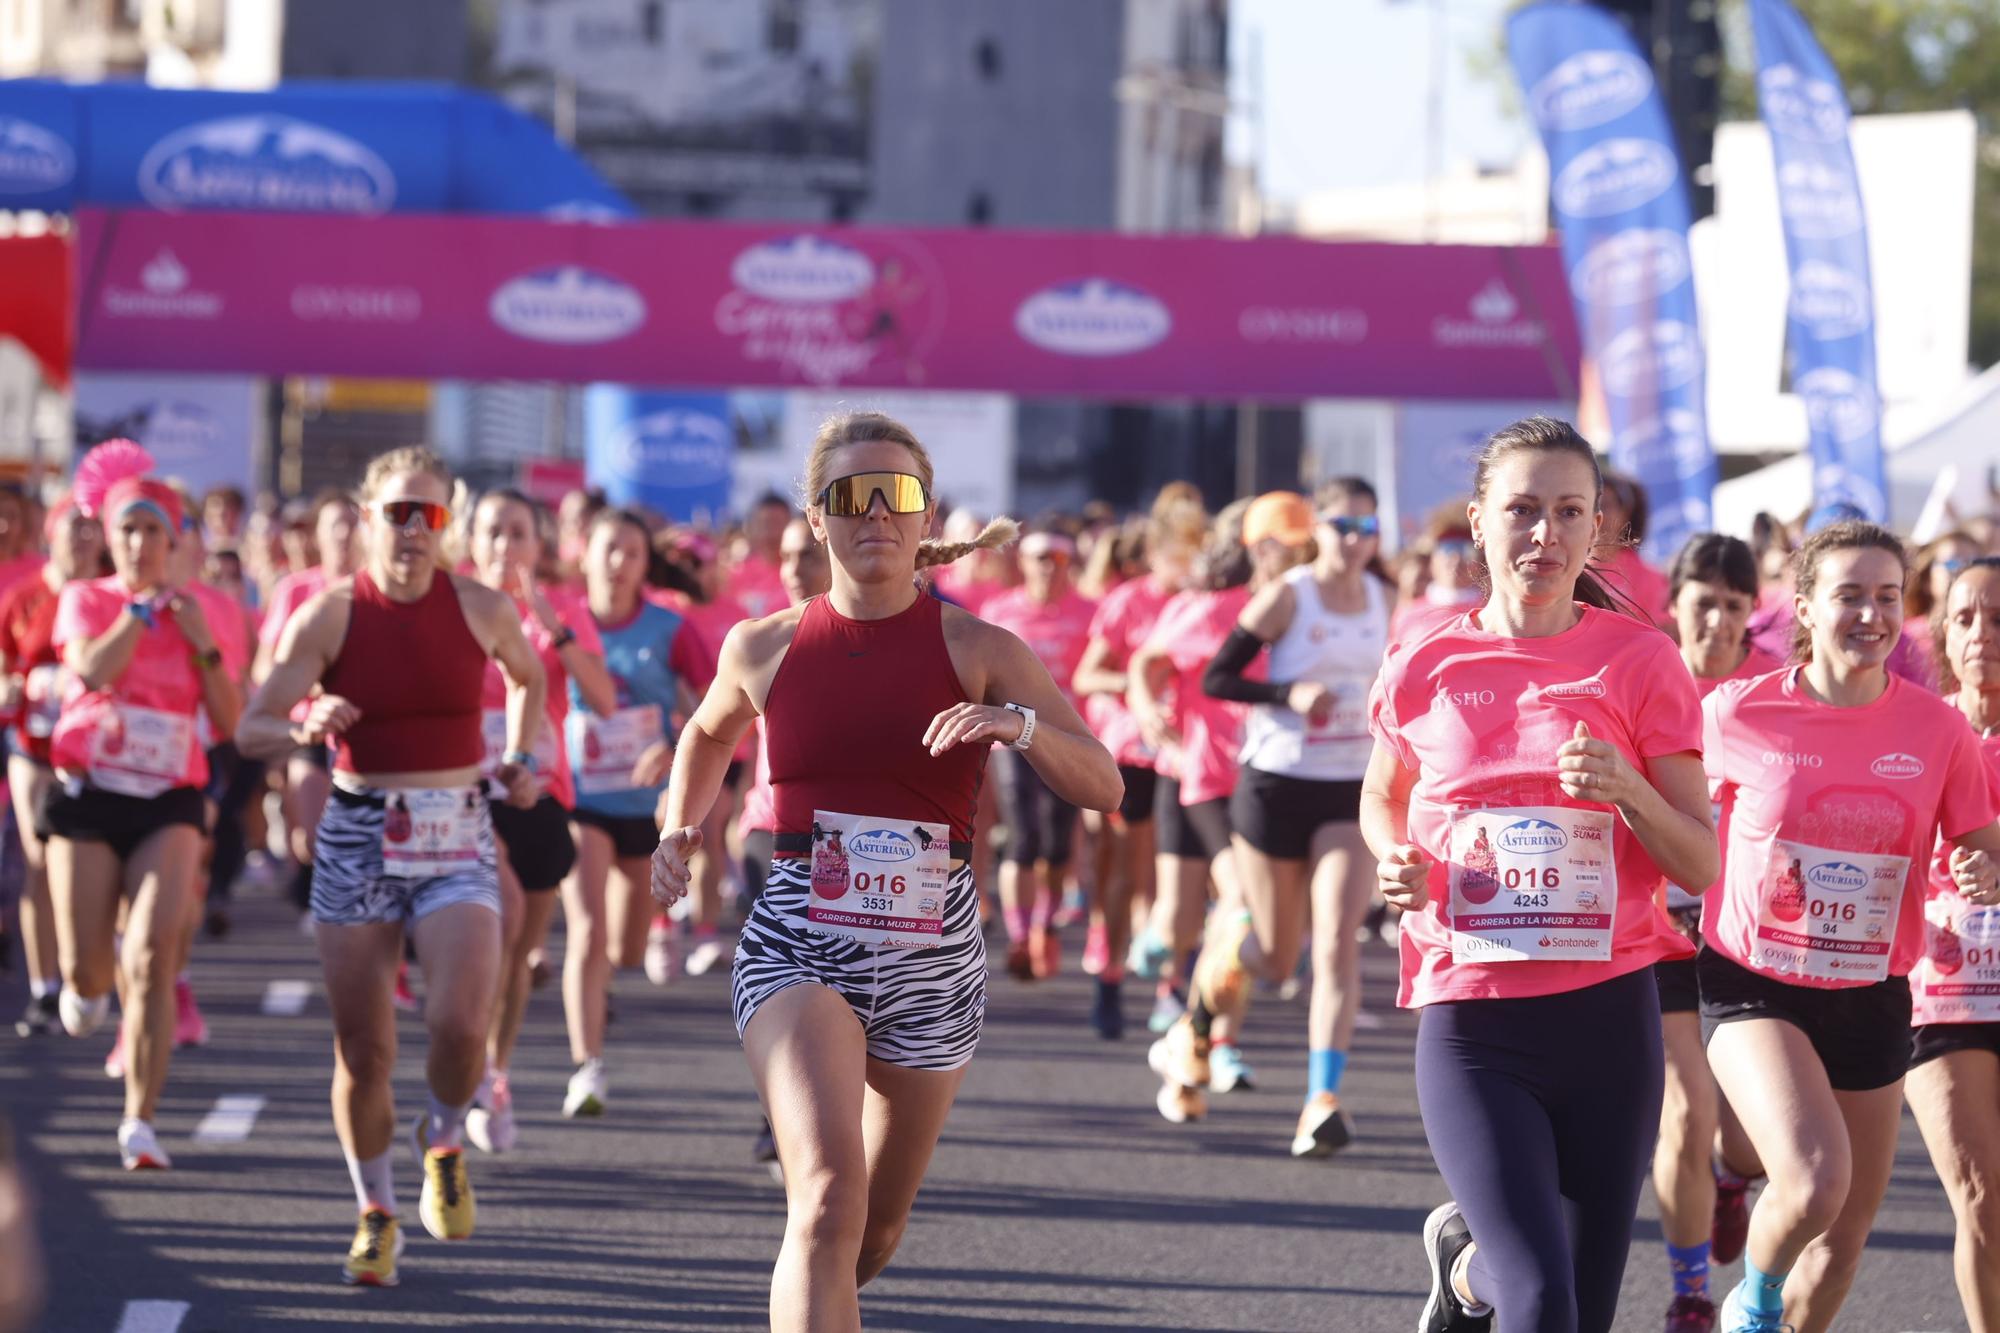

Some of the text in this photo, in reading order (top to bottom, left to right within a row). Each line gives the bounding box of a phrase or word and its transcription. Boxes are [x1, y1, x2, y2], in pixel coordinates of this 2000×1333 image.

[1550, 685, 1602, 695] ASTURIANA
[1432, 690, 1495, 713] OYSHO
[1762, 751, 1823, 768] OYSHO
[1875, 761, 1920, 773] ASTURIANA
[1502, 833, 1563, 846] ASTURIANA
[1573, 831, 1602, 841] SUMA
[854, 840, 911, 857] ASTURIANA
[854, 872, 906, 894] 016
[1504, 867, 1560, 889] 016
[1813, 870, 1864, 886] ASTURIANA
[862, 897, 893, 911] 3531
[1513, 894, 1549, 907] 4243
[1809, 899, 1857, 921] 016
[816, 912, 938, 931] CARRERA DE LA MUJER 2023
[1469, 917, 1599, 927] CARRERA DE LA MUJER 2023
[1822, 923, 1837, 935] 94
[1467, 937, 1600, 950] OYSHO Santander
[1772, 931, 1810, 946] CARRERA
[1811, 939, 1823, 948] DE
[1824, 940, 1835, 949] LA
[1836, 942, 1862, 952] MUJER
[1764, 947, 1879, 970] OYSHO Santander
[1967, 948, 2000, 966] 01
